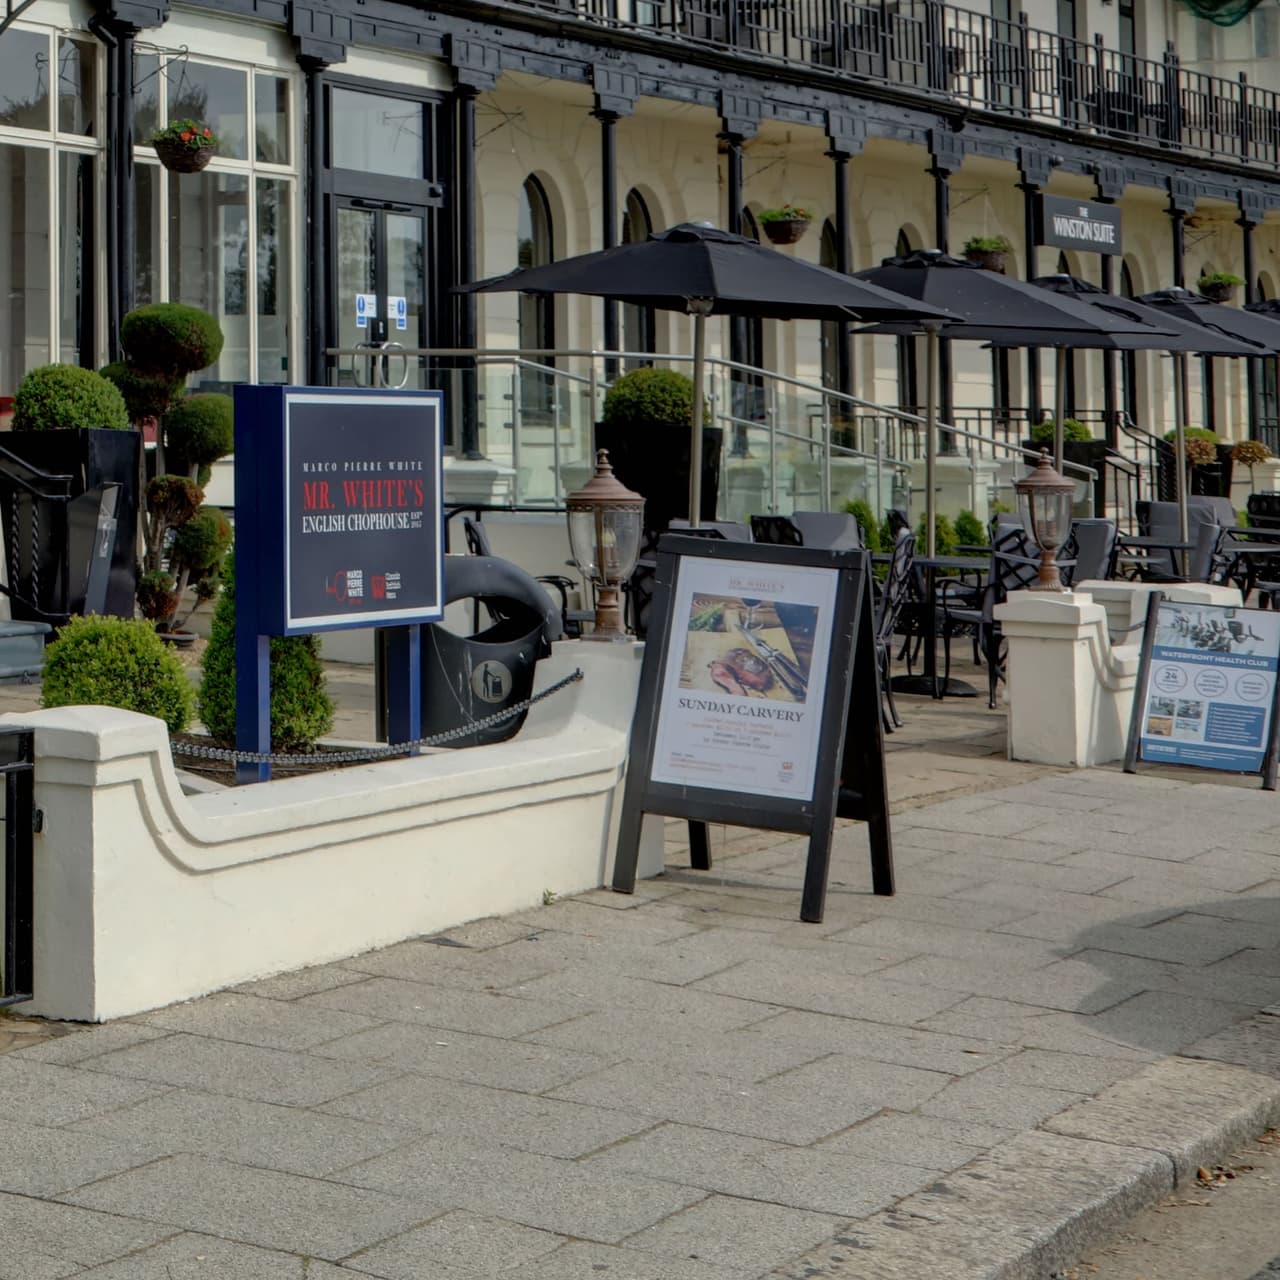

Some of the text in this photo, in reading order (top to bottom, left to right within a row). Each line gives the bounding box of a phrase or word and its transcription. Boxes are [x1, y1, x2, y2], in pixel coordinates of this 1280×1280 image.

[1053, 216, 1115, 244] WINSTON SUITE
[303, 461, 423, 472] MARCO PIERRE WHITE
[303, 479, 424, 510] MR. WHITE'S
[302, 511, 410, 533] ENGLISH CHOPHOUSE
[1161, 650, 1214, 662] WATERFRONT
[1215, 657, 1247, 665] HEALTH
[678, 697, 805, 723] SUNDAY CARVERY
